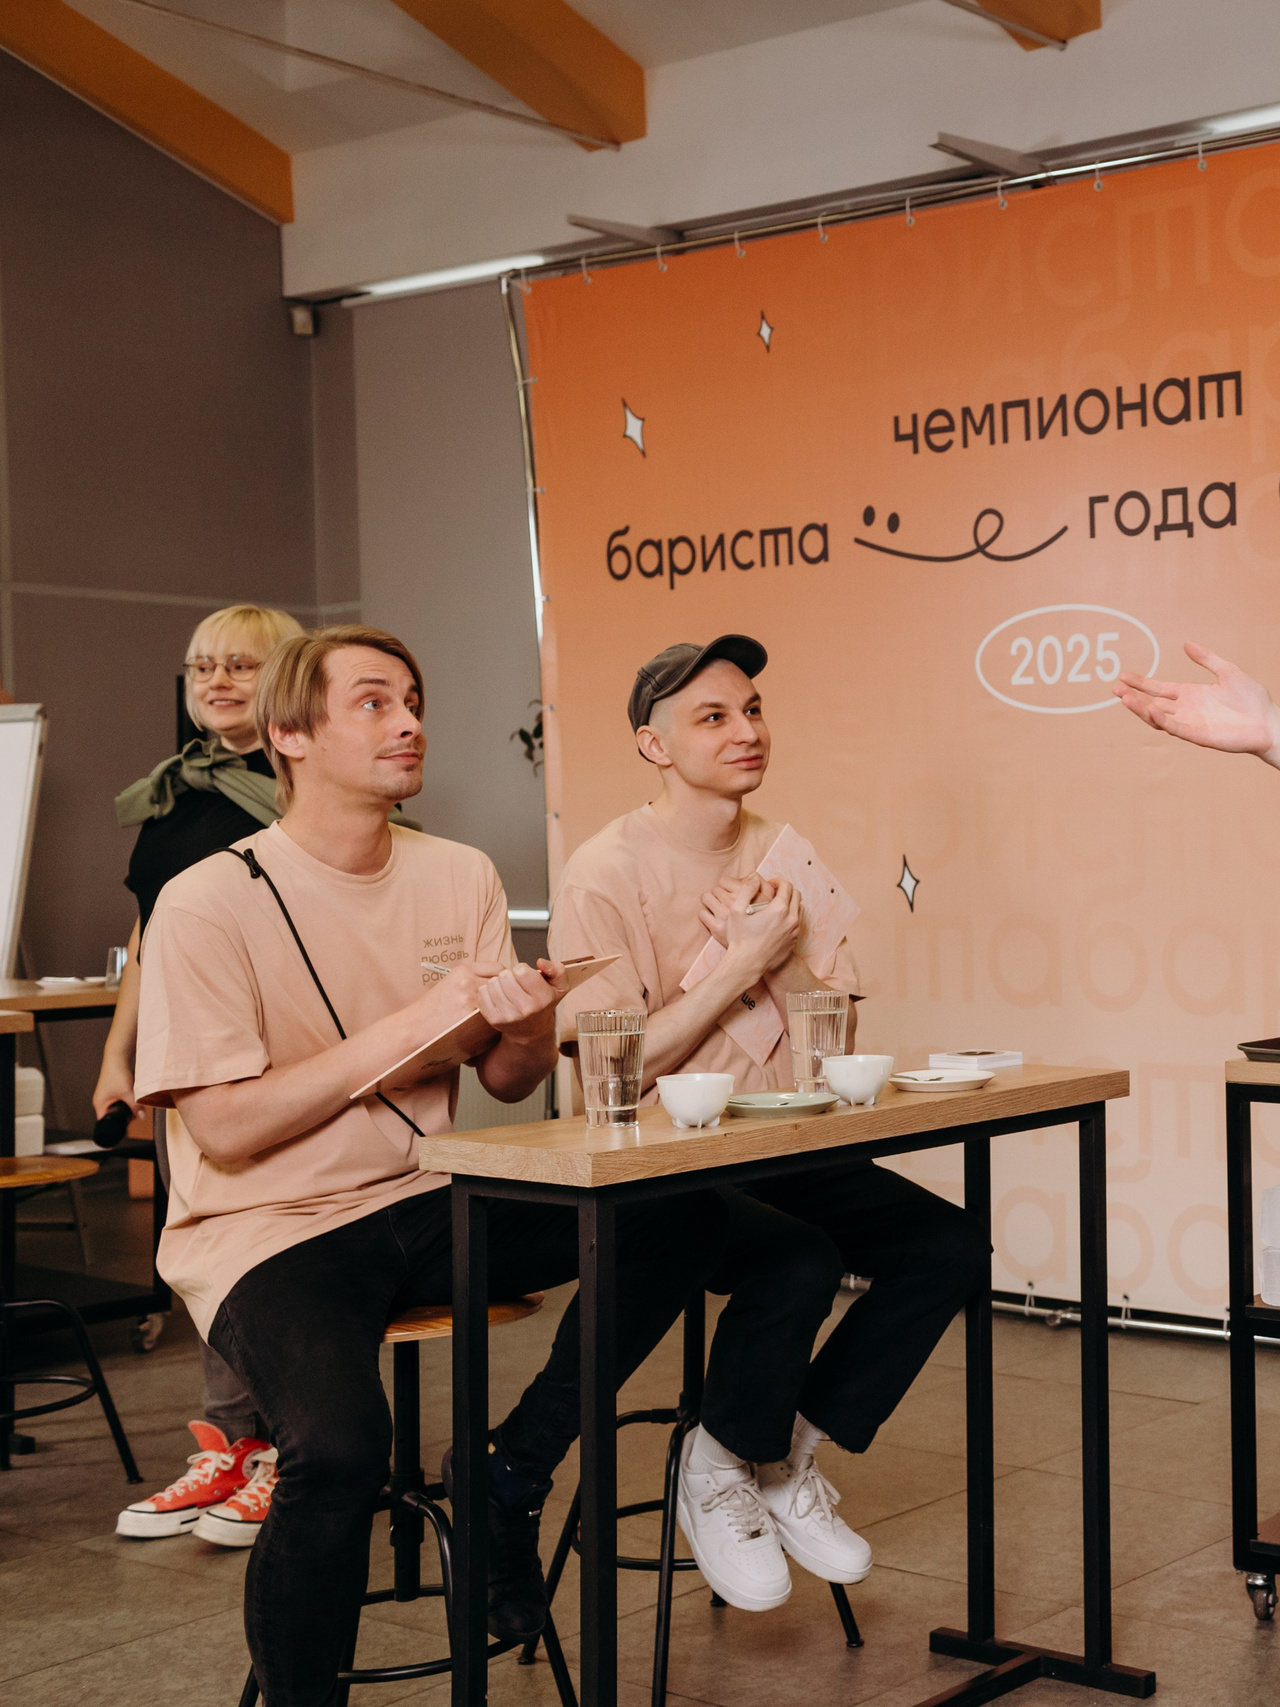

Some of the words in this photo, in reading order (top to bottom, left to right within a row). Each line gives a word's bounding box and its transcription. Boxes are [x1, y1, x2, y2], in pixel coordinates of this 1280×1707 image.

[893, 370, 1243, 455] чемпионат
[606, 523, 829, 590] бариста
[1088, 481, 1237, 541] года
[1010, 632, 1121, 685] 2025
[422, 934, 464, 949] жизнь
[421, 972, 447, 986] ра
